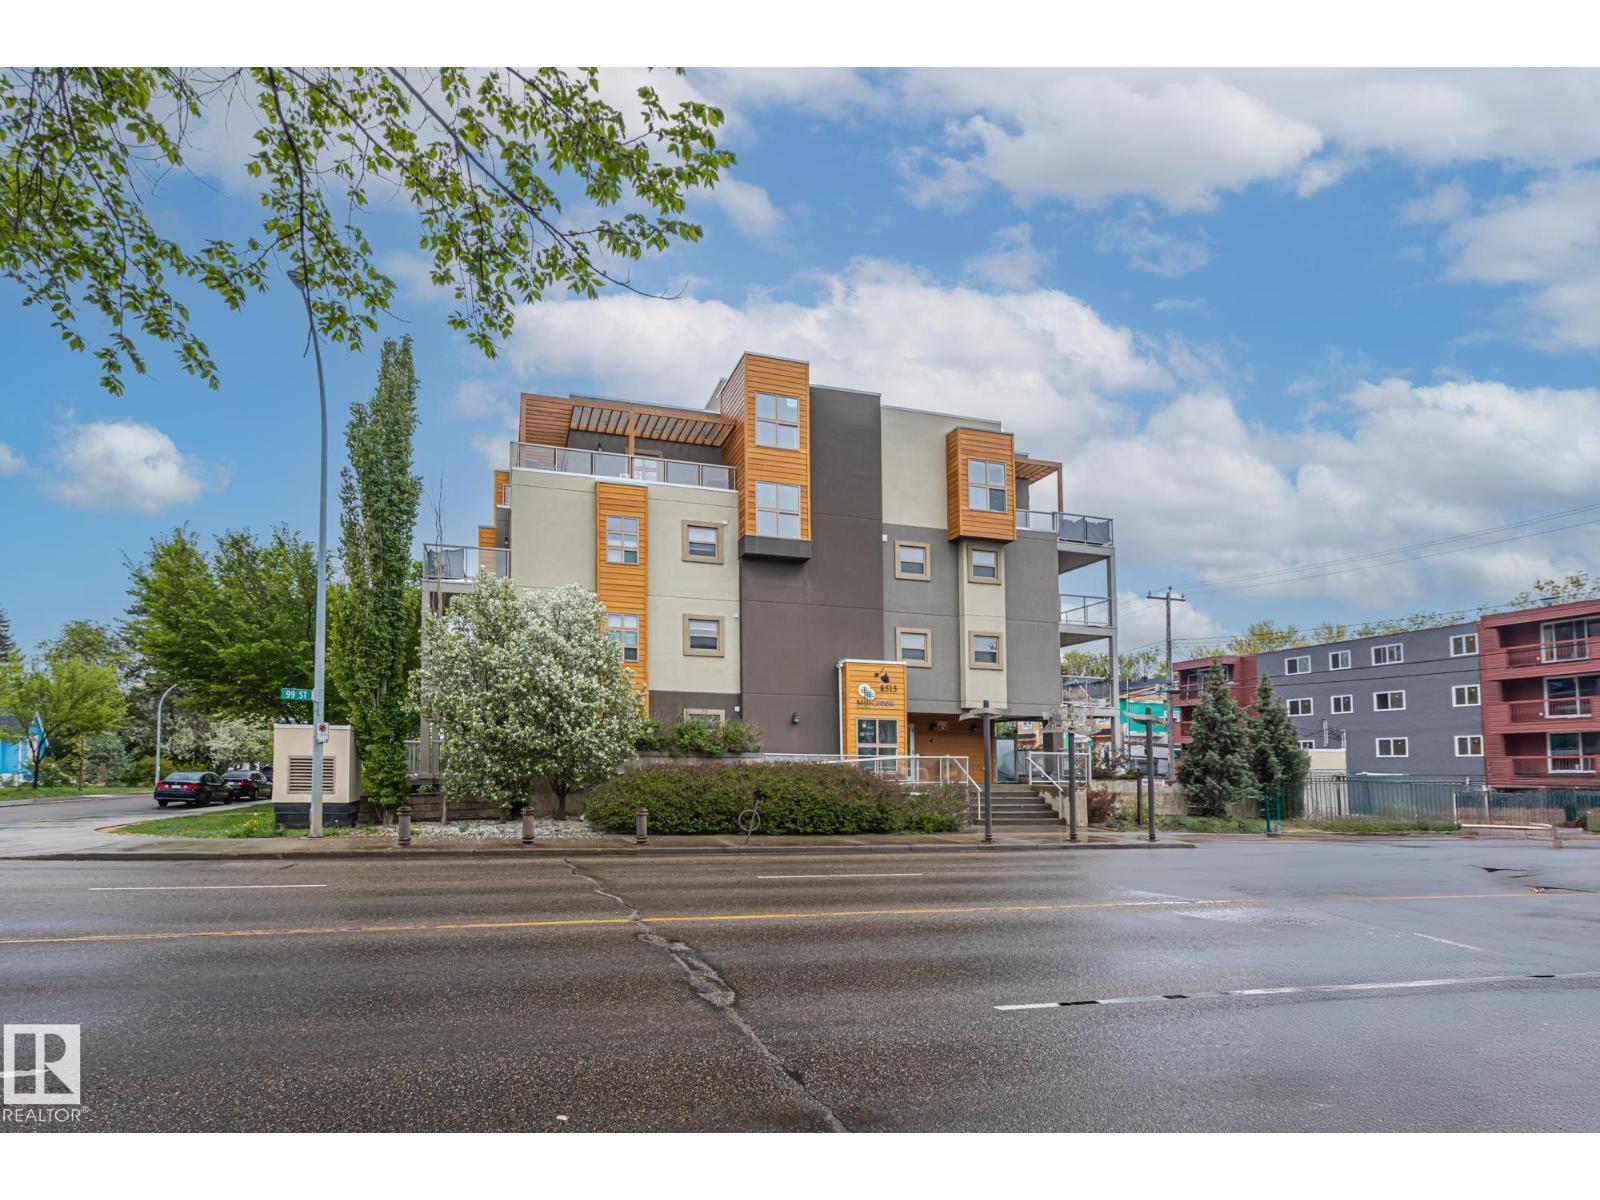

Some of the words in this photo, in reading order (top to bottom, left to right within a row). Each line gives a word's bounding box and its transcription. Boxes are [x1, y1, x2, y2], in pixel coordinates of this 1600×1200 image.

[880, 684, 897, 693] 8515
[285, 690, 296, 699] 99
[299, 691, 307, 700] ST
